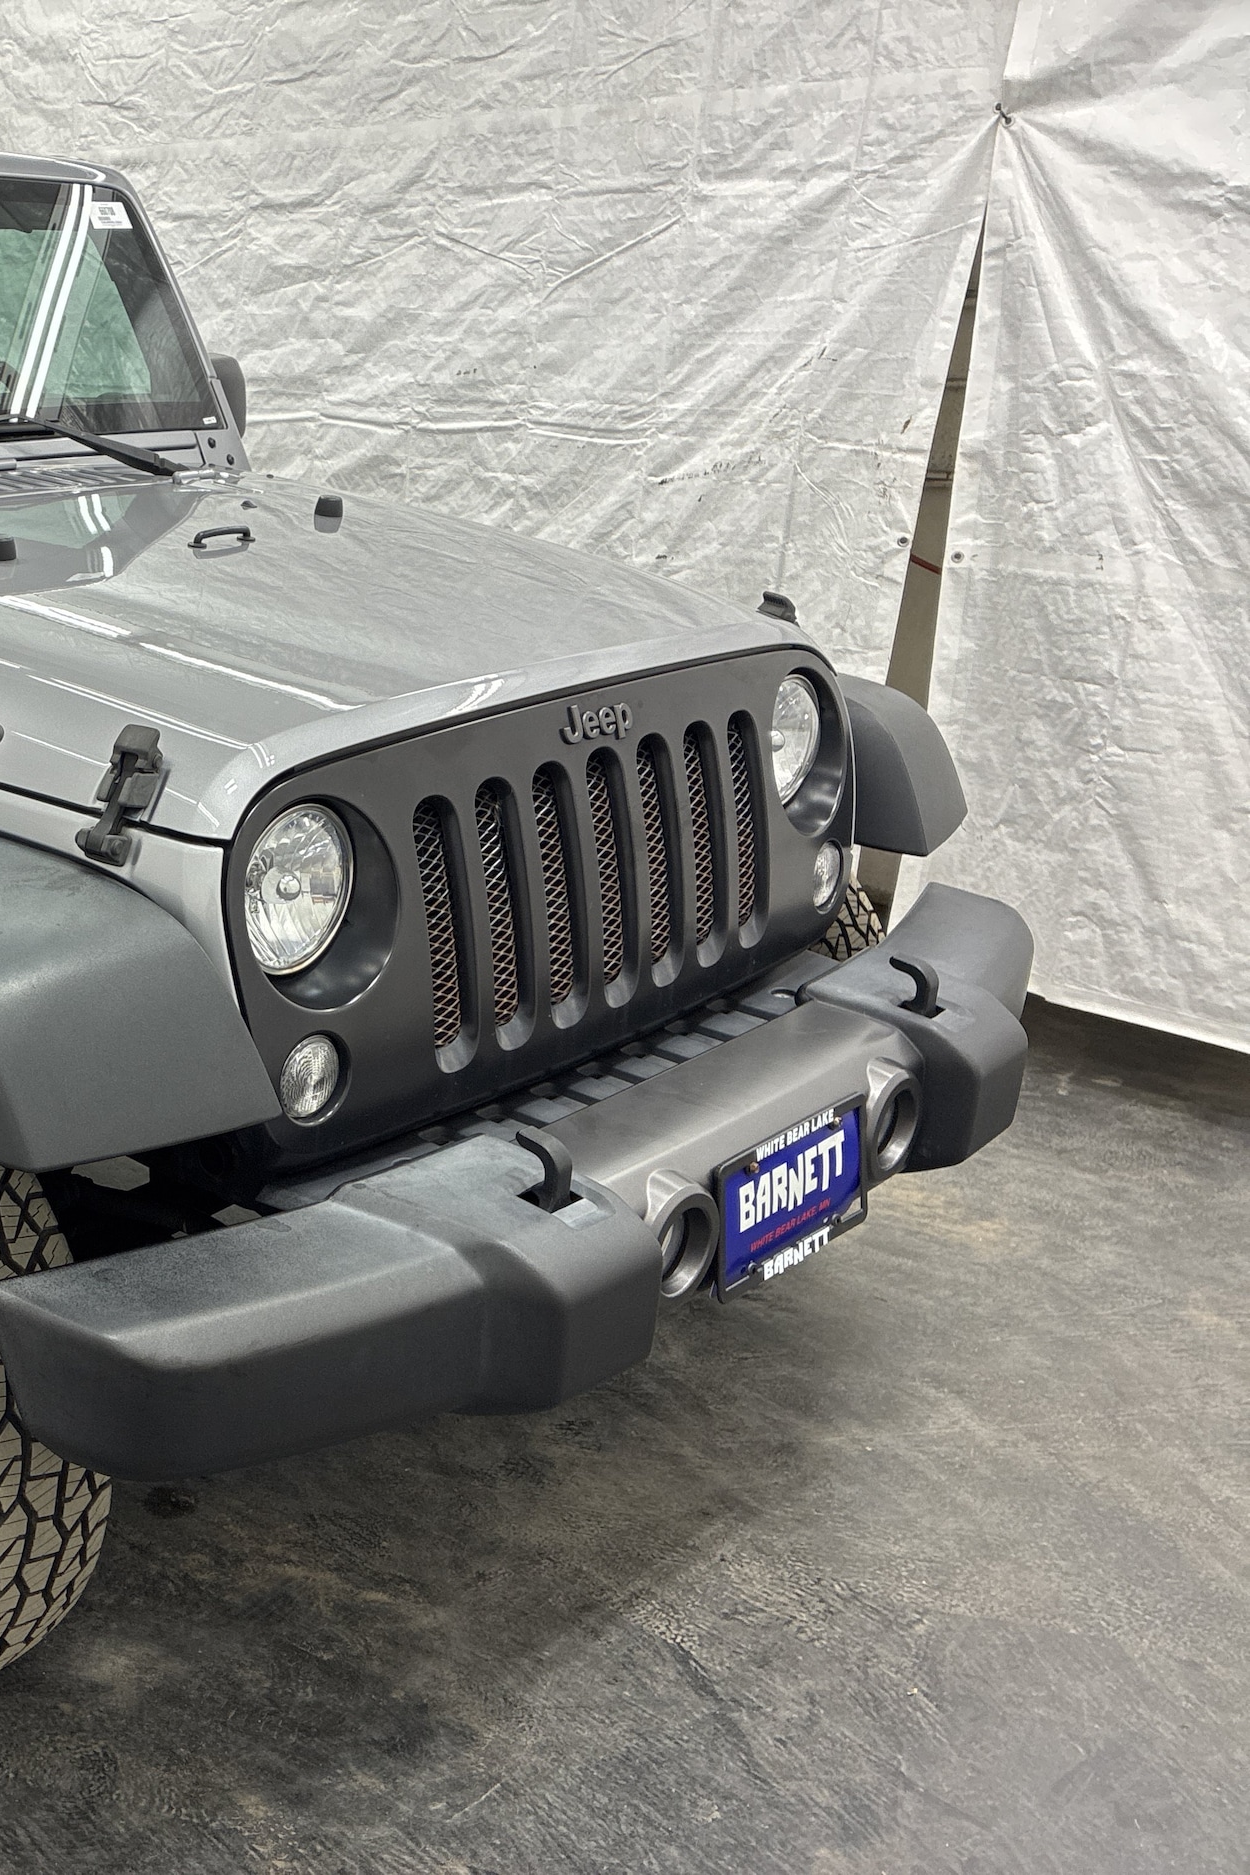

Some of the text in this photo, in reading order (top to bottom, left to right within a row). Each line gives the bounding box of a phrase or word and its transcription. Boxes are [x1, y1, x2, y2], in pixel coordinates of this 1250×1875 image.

[560, 702, 633, 744] Jeep
[756, 1108, 835, 1162] WHITE BEAR LAKE
[739, 1129, 845, 1234] BARNETT
[750, 1230, 775, 1253] WHITE
[775, 1217, 797, 1239] BEAR
[763, 1226, 830, 1281] BARNETT
